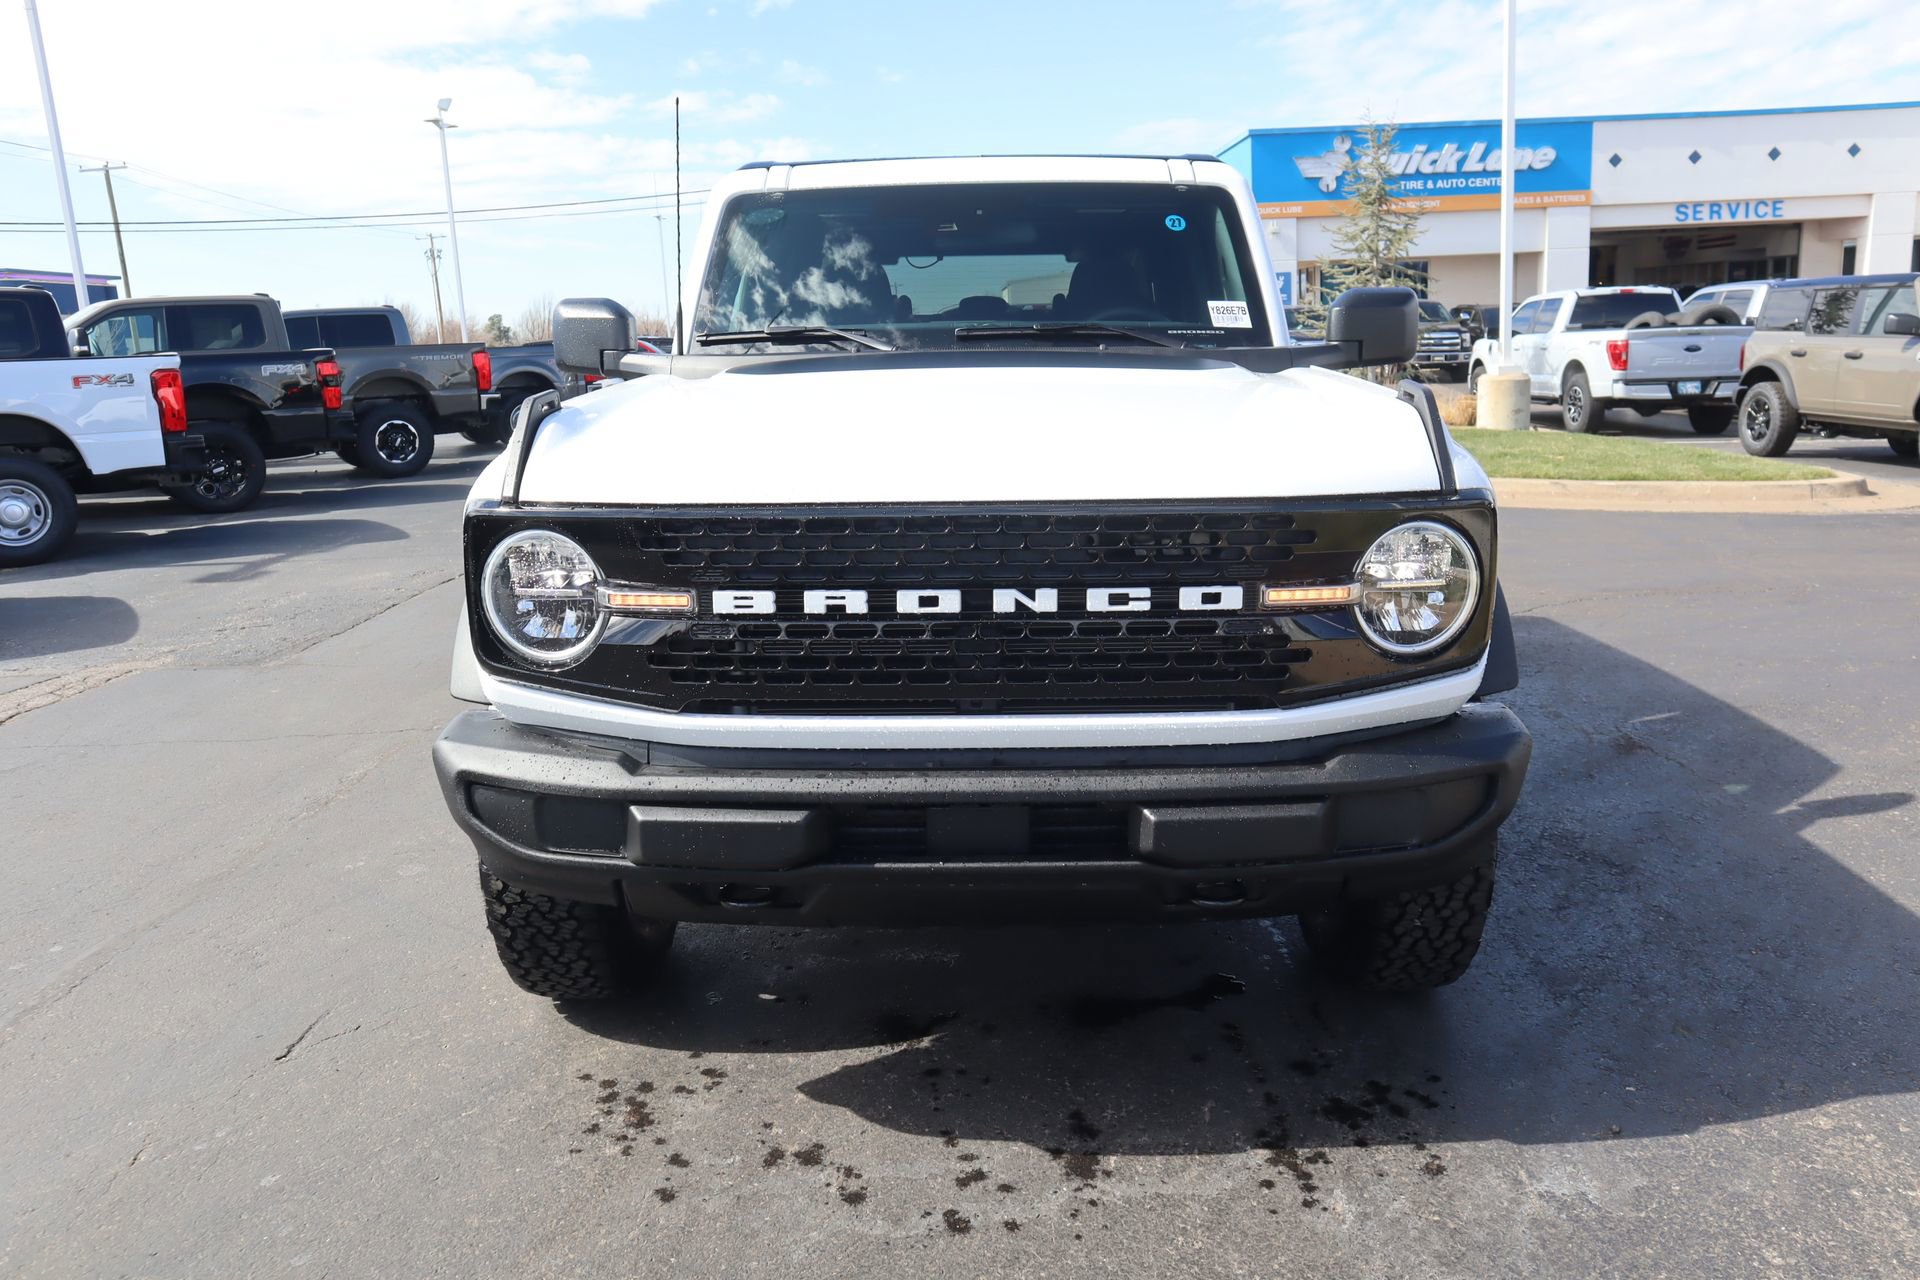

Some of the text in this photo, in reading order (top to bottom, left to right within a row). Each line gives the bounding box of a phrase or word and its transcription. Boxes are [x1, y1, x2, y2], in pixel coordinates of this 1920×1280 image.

[1400, 177, 1503, 190] TIRE & AUTO CENTE
[1514, 195, 1534, 205] AKES
[1543, 193, 1586, 204] BATTERIES
[1282, 206, 1303, 214] LUBE
[1675, 200, 1784, 222] SERVICE
[1210, 305, 1247, 316] Y826E7B
[261, 364, 306, 376] FX4
[71, 373, 135, 389] FX4
[712, 585, 1244, 614] BRONCO
